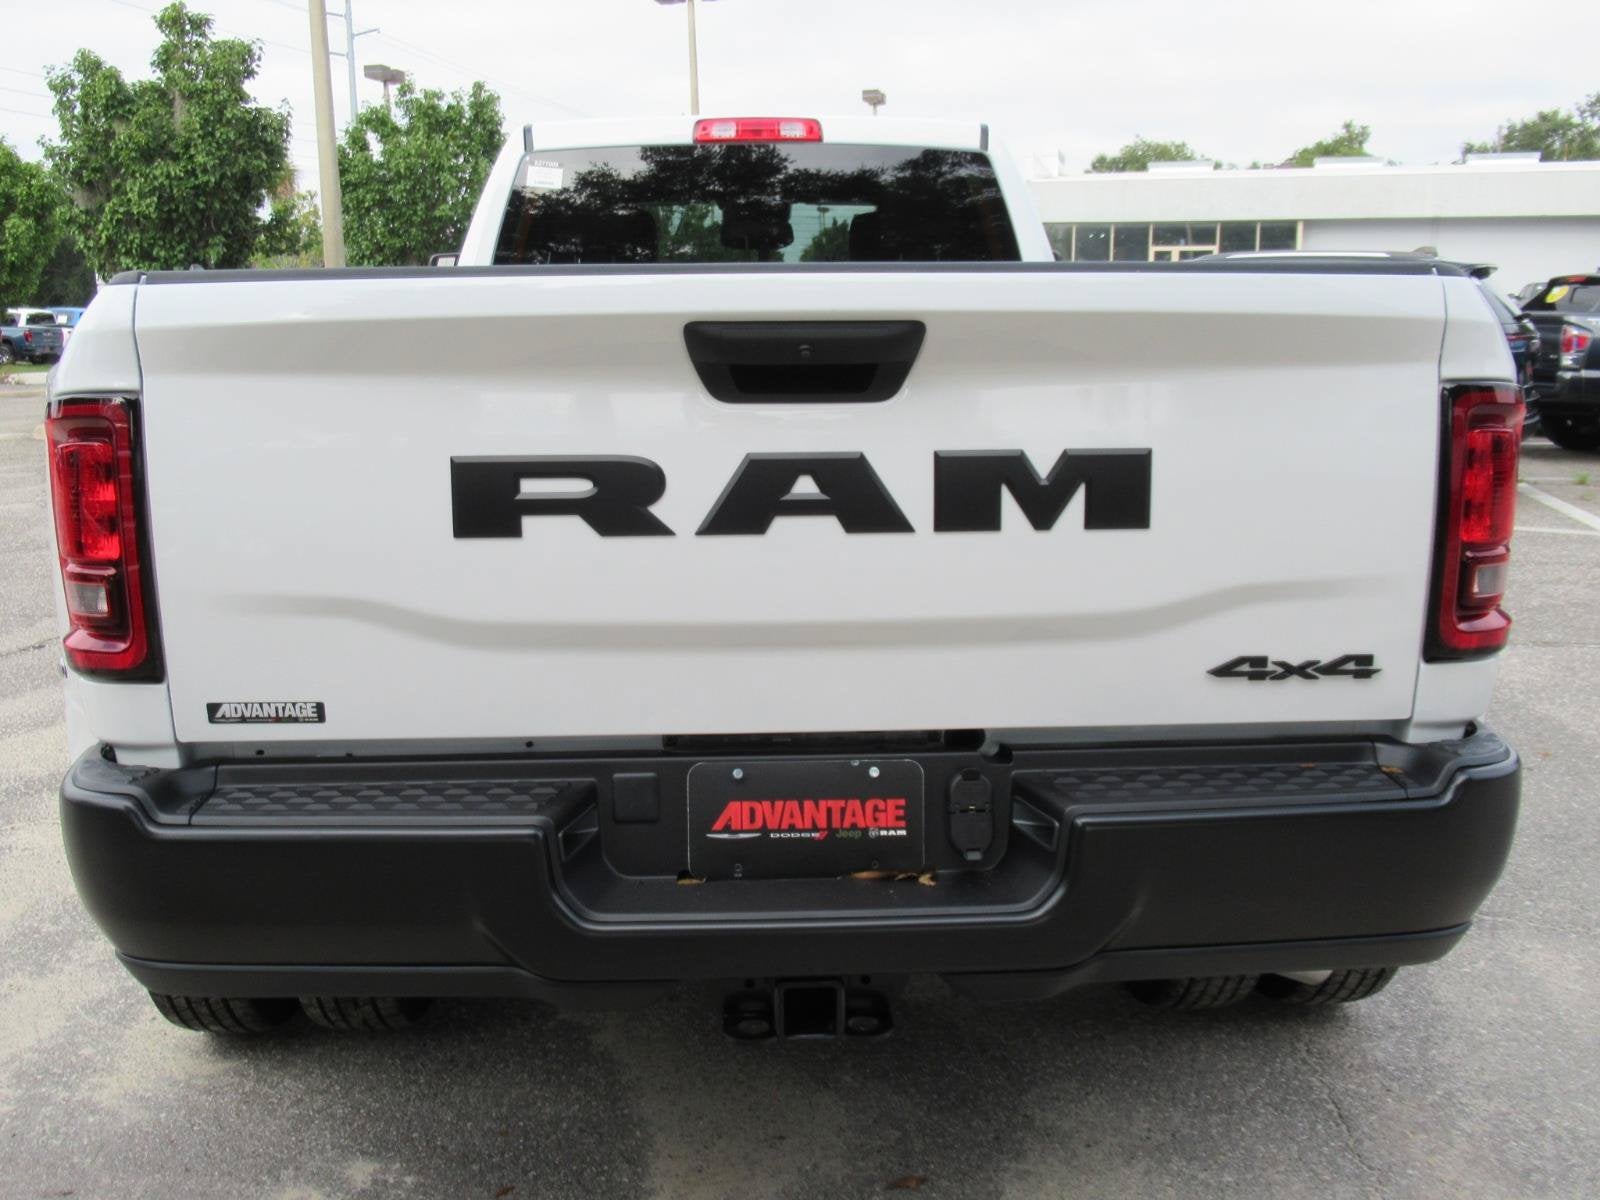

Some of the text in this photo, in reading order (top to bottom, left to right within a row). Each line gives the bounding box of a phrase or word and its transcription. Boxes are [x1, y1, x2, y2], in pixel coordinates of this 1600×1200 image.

[450, 448, 1152, 538] RAM
[215, 702, 318, 718] ADVANTAGE
[711, 799, 906, 831] ADVANTAGE
[835, 829, 862, 839] Jeep
